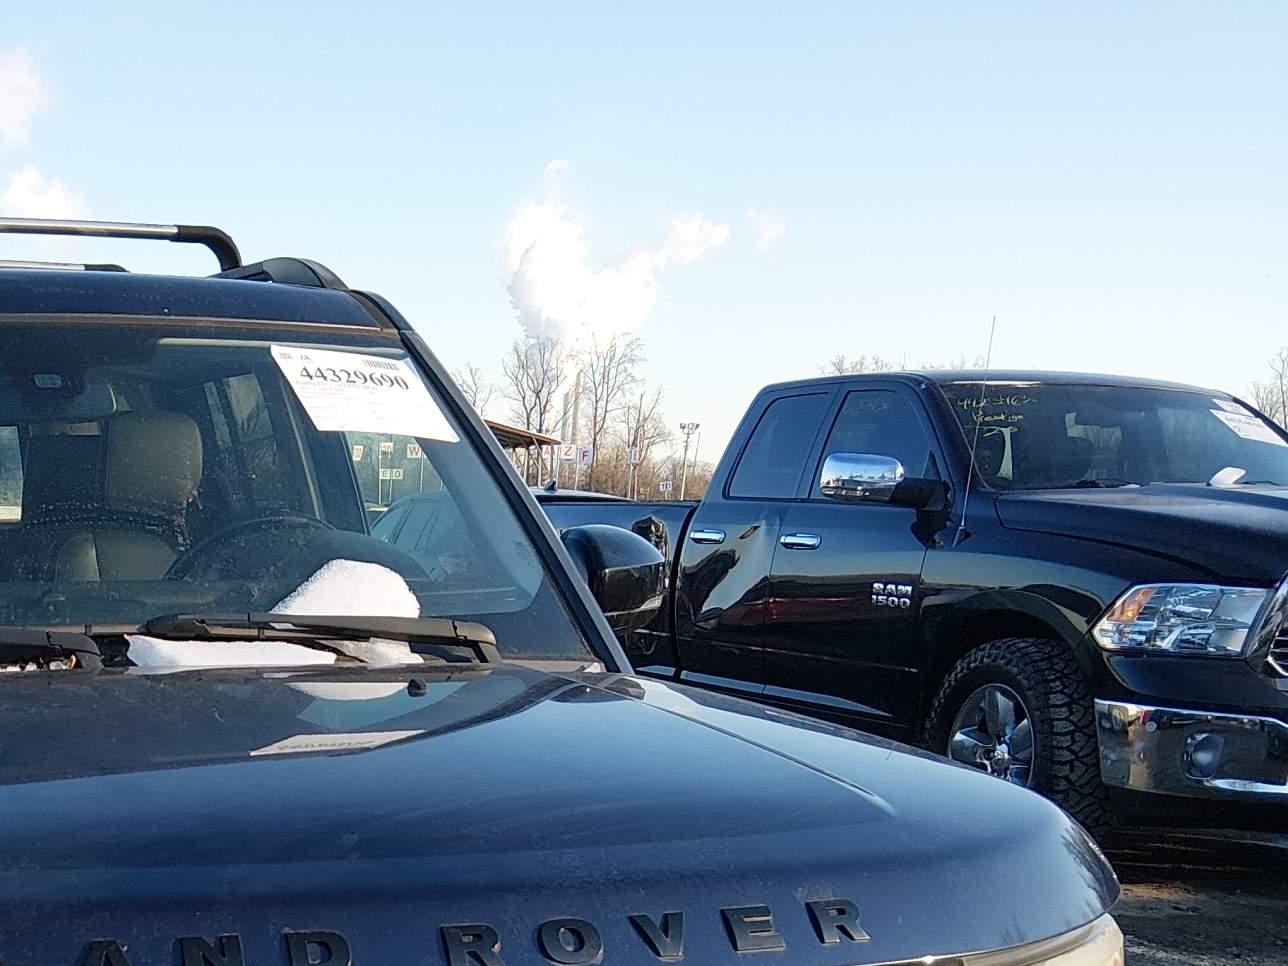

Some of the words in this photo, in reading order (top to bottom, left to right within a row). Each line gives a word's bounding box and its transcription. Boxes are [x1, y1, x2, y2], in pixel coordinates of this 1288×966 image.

[299, 366, 409, 390] 44329690
[408, 446, 420, 457] W
[564, 446, 572, 456] Z
[582, 450, 589, 461] F
[872, 582, 913, 596] RAM
[871, 594, 912, 608] 1500
